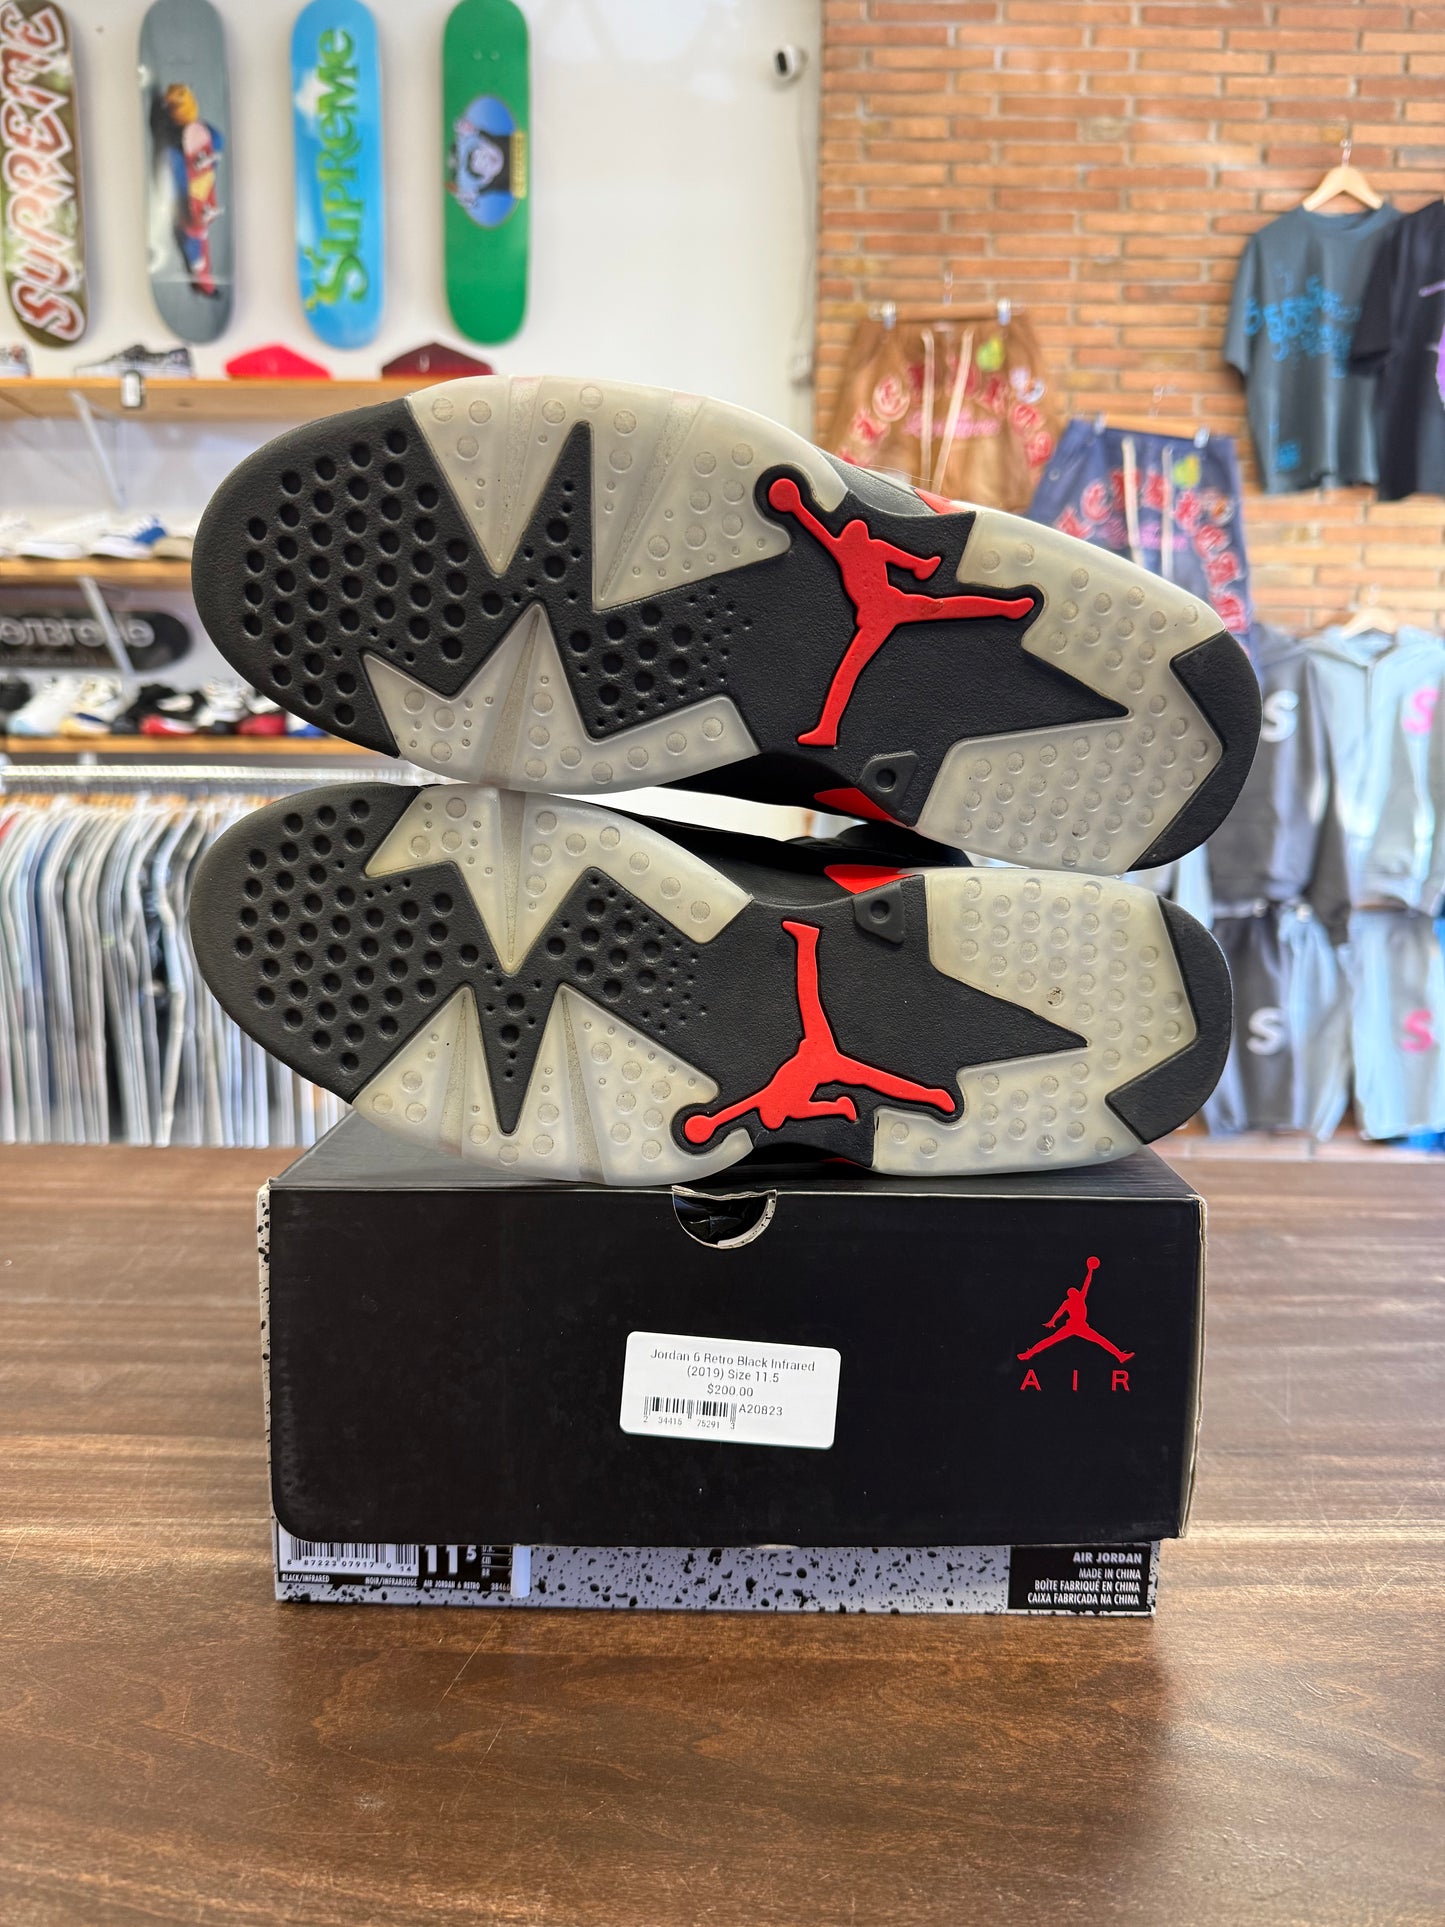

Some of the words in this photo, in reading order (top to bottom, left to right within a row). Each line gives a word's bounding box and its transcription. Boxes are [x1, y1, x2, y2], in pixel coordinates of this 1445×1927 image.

[1247, 1007, 1286, 1056] S
[1402, 1009, 1435, 1053] S
[650, 1348, 691, 1362] Jordan
[693, 1352, 701, 1362] 6
[704, 1353, 734, 1366] Retro
[737, 1355, 768, 1368] Black
[771, 1358, 816, 1372] Infrared
[687, 1365, 724, 1381] (2019)
[727, 1369, 751, 1381] Size
[755, 1371, 780, 1383] 11.5
[706, 1383, 754, 1398] $200.00
[738, 1403, 783, 1416] A20823
[1073, 1552, 1093, 1564] AIR
[1096, 1552, 1143, 1564] JORDAN
[1079, 1568, 1102, 1579] MADE
[1104, 1568, 1113, 1579] IN
[1116, 1568, 1141, 1580] CHINA
[435, 1580, 455, 1588] JORDAN
[1034, 1578, 1057, 1591] BOÎTE
[1060, 1578, 1100, 1593] FABRIQUÉ
[1102, 1581, 1113, 1592] EN
[1115, 1581, 1141, 1593] CHINA
[1027, 1592, 1051, 1604] CAIXA
[1053, 1592, 1098, 1605] FABRICADA
[1100, 1593, 1111, 1605] NA
[1114, 1594, 1140, 1606] CHINA
